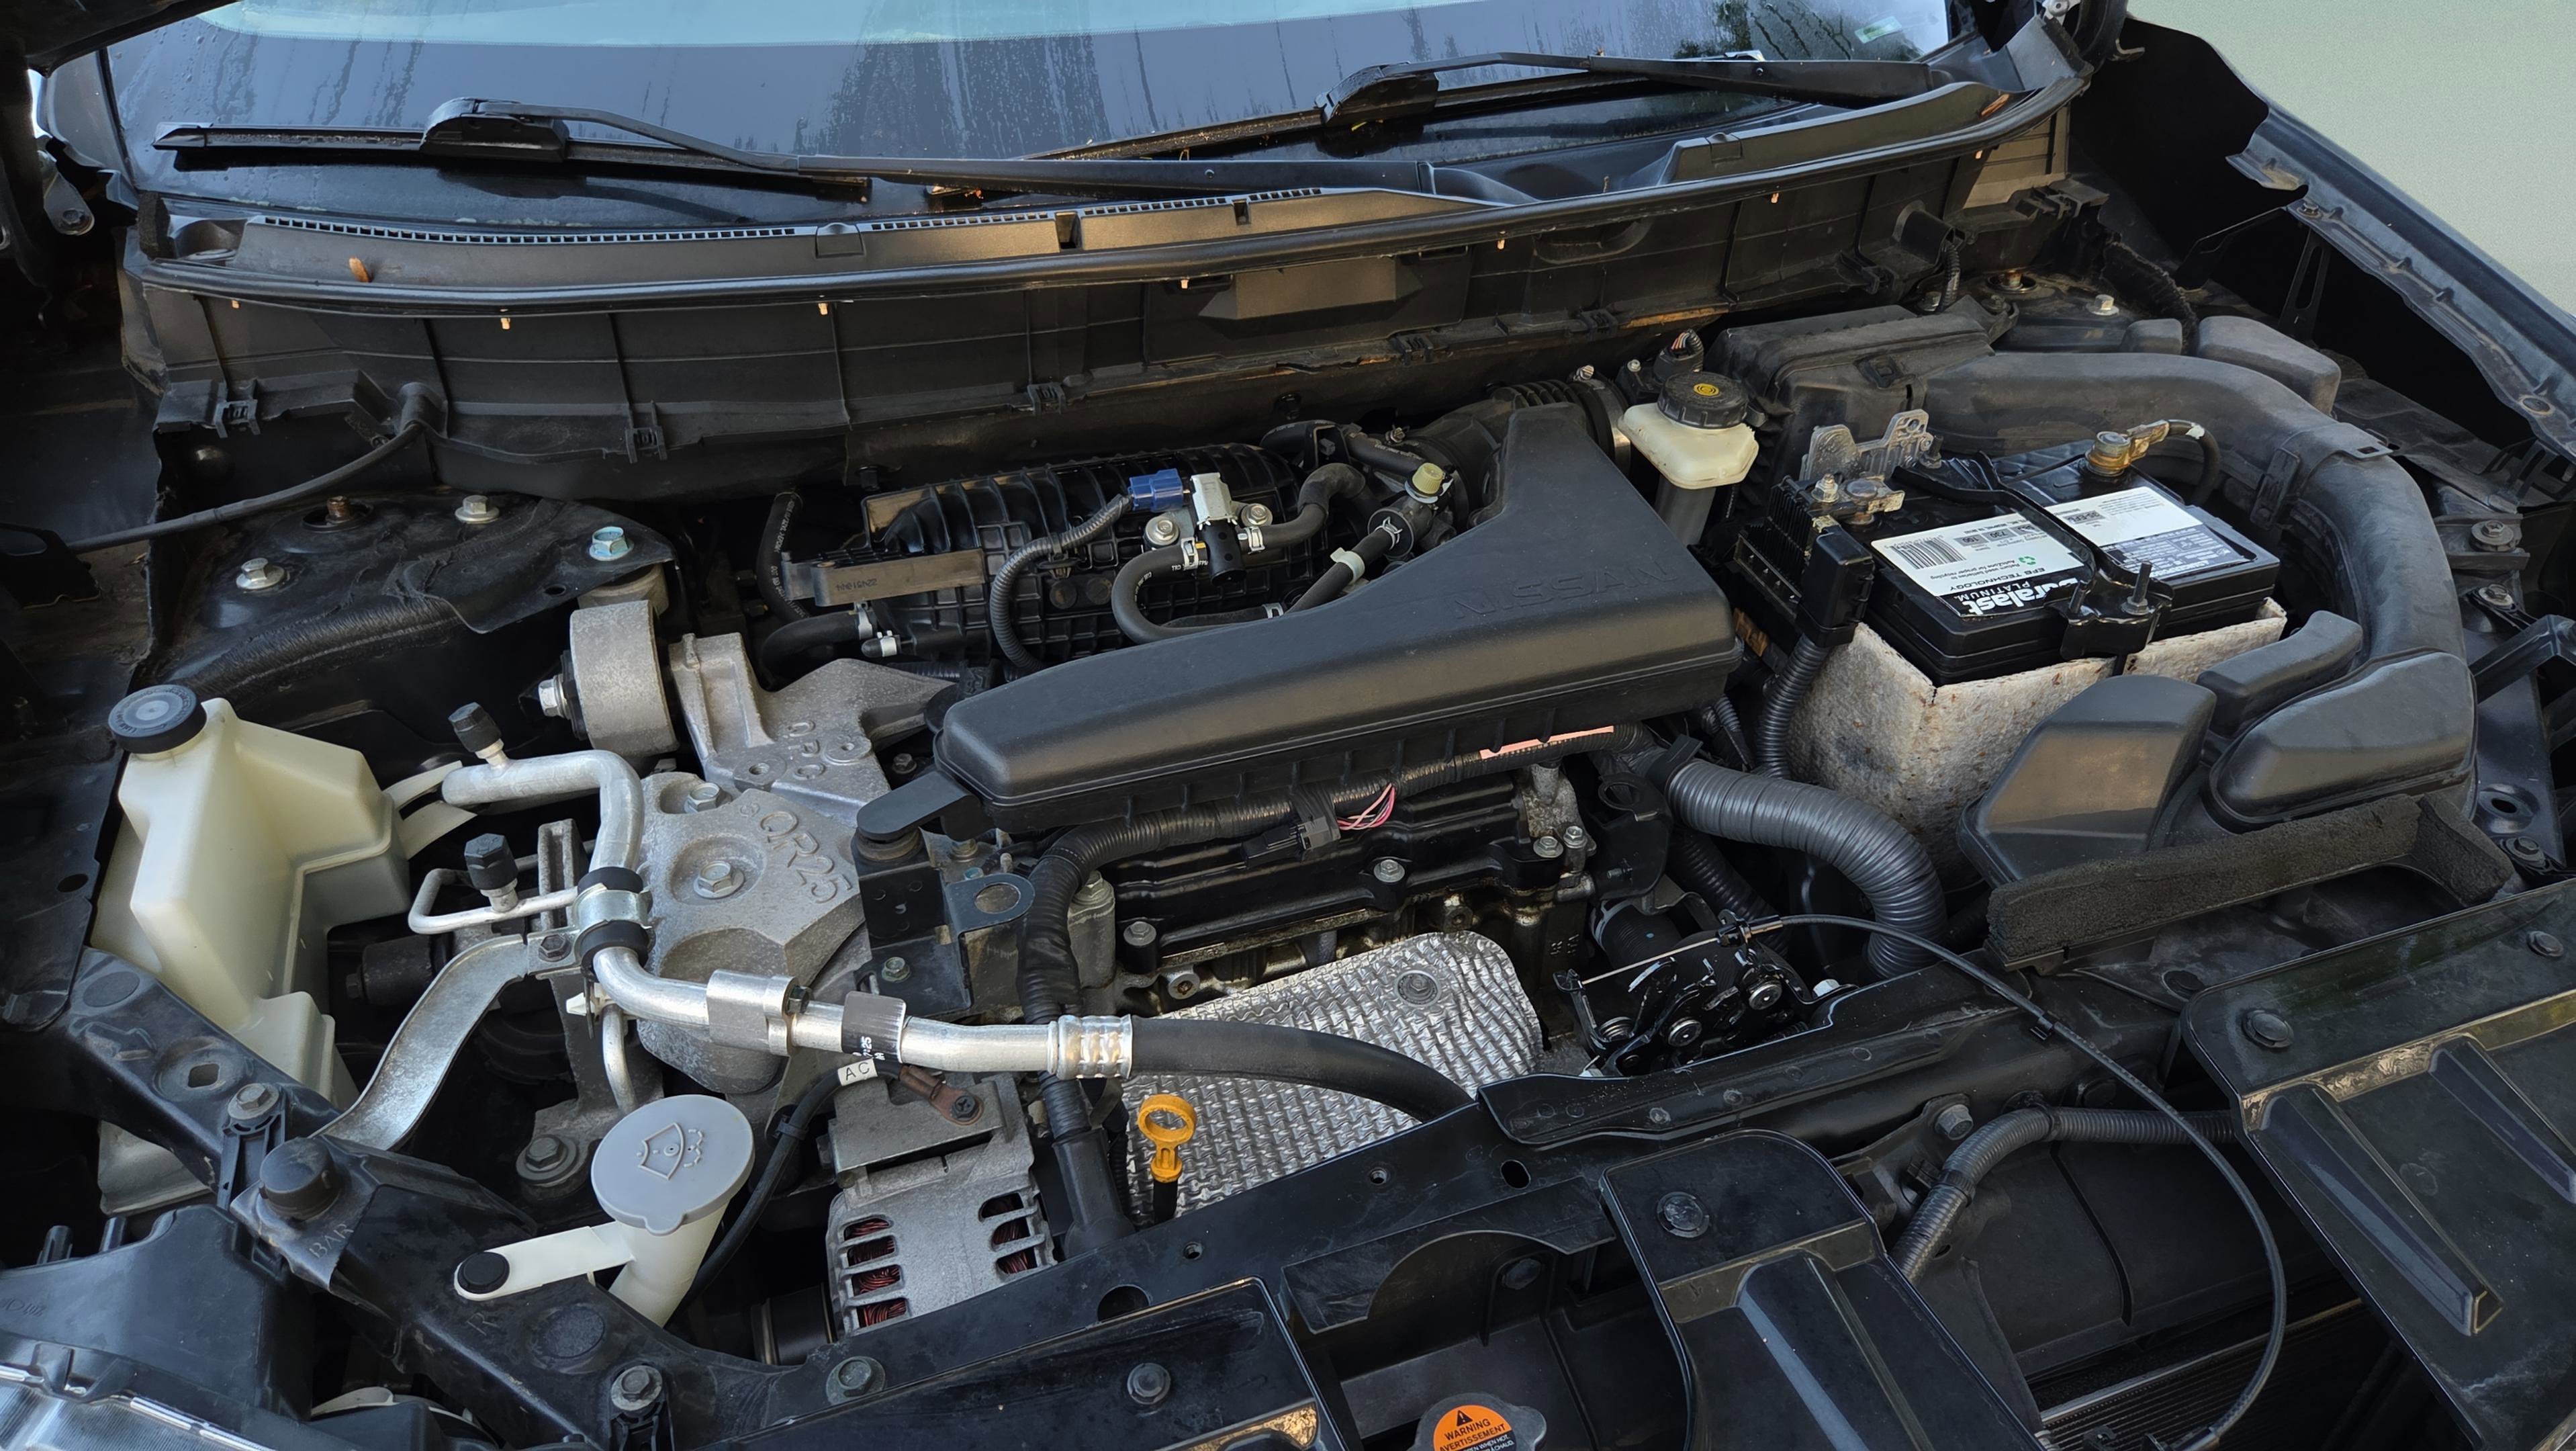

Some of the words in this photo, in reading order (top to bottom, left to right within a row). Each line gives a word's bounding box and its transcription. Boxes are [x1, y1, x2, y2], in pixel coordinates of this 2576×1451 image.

[1990, 530, 2007, 539] 730
[1949, 573, 2021, 591] TECHNOLOGY
[2024, 567, 2045, 576] EFB
[1451, 559, 1677, 619] NISSAN
[1957, 580, 2030, 601] PLATINUM
[1962, 577, 2078, 616] uralast
[760, 810, 853, 904] QR25
[309, 1223, 355, 1259] BAR
[1439, 1423, 1506, 1451] AVERTISSEMENT
[1444, 1418, 1491, 1441] WARNING
[1478, 1439, 1497, 1449] WHEN
